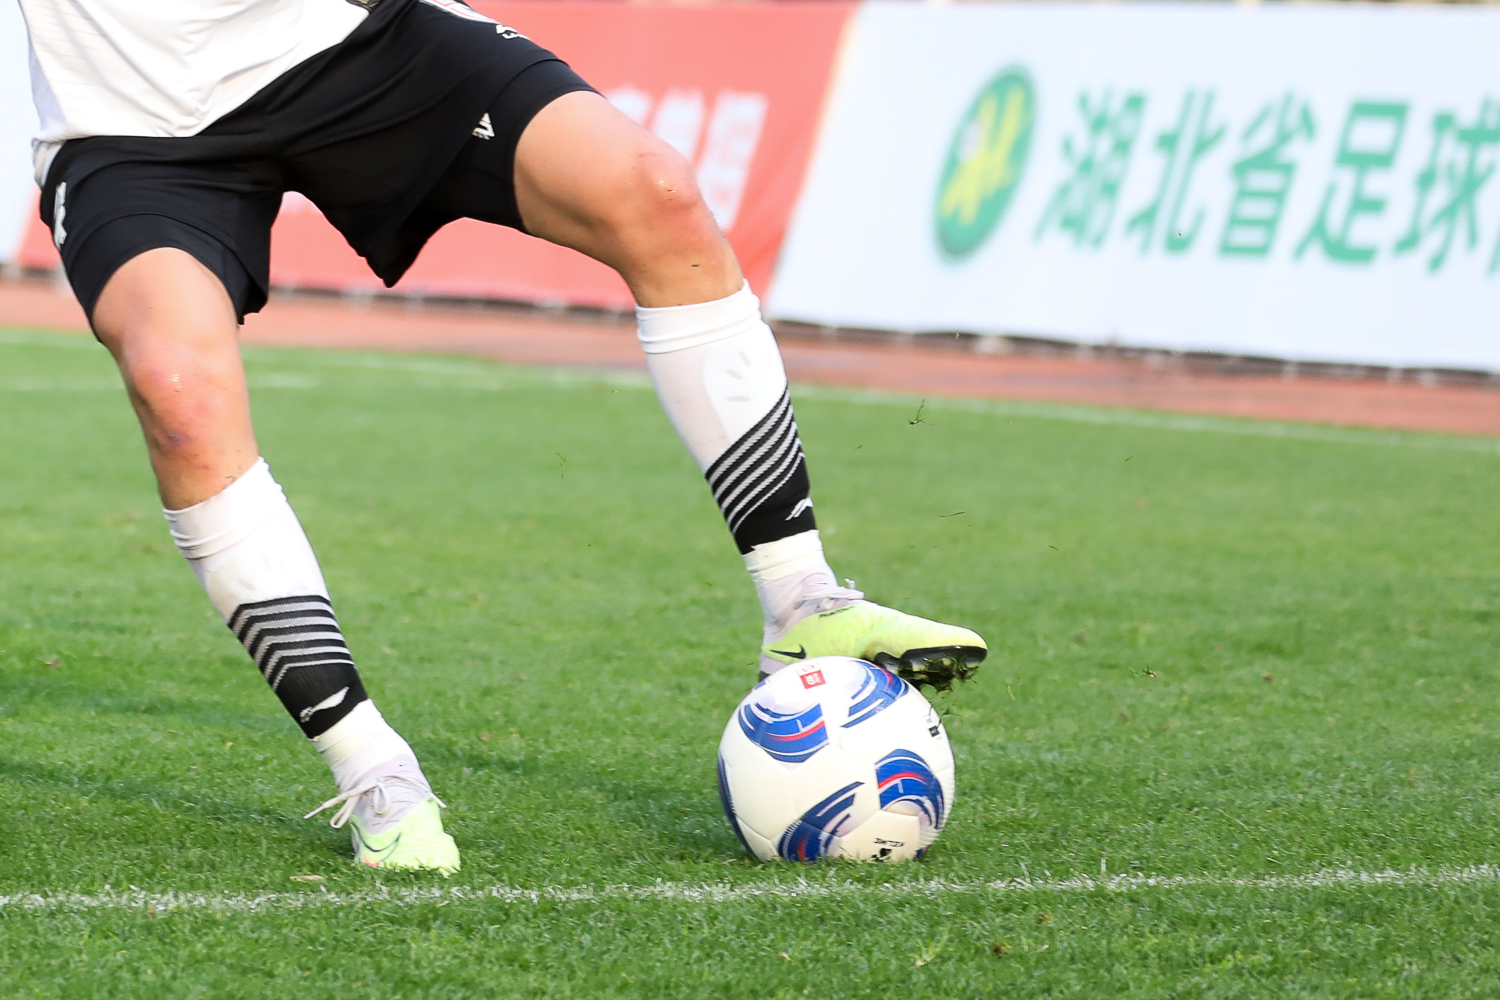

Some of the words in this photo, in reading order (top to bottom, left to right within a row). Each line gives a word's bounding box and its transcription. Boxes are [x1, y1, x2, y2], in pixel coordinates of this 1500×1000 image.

[1032, 89, 1500, 276] 湖北省足球
